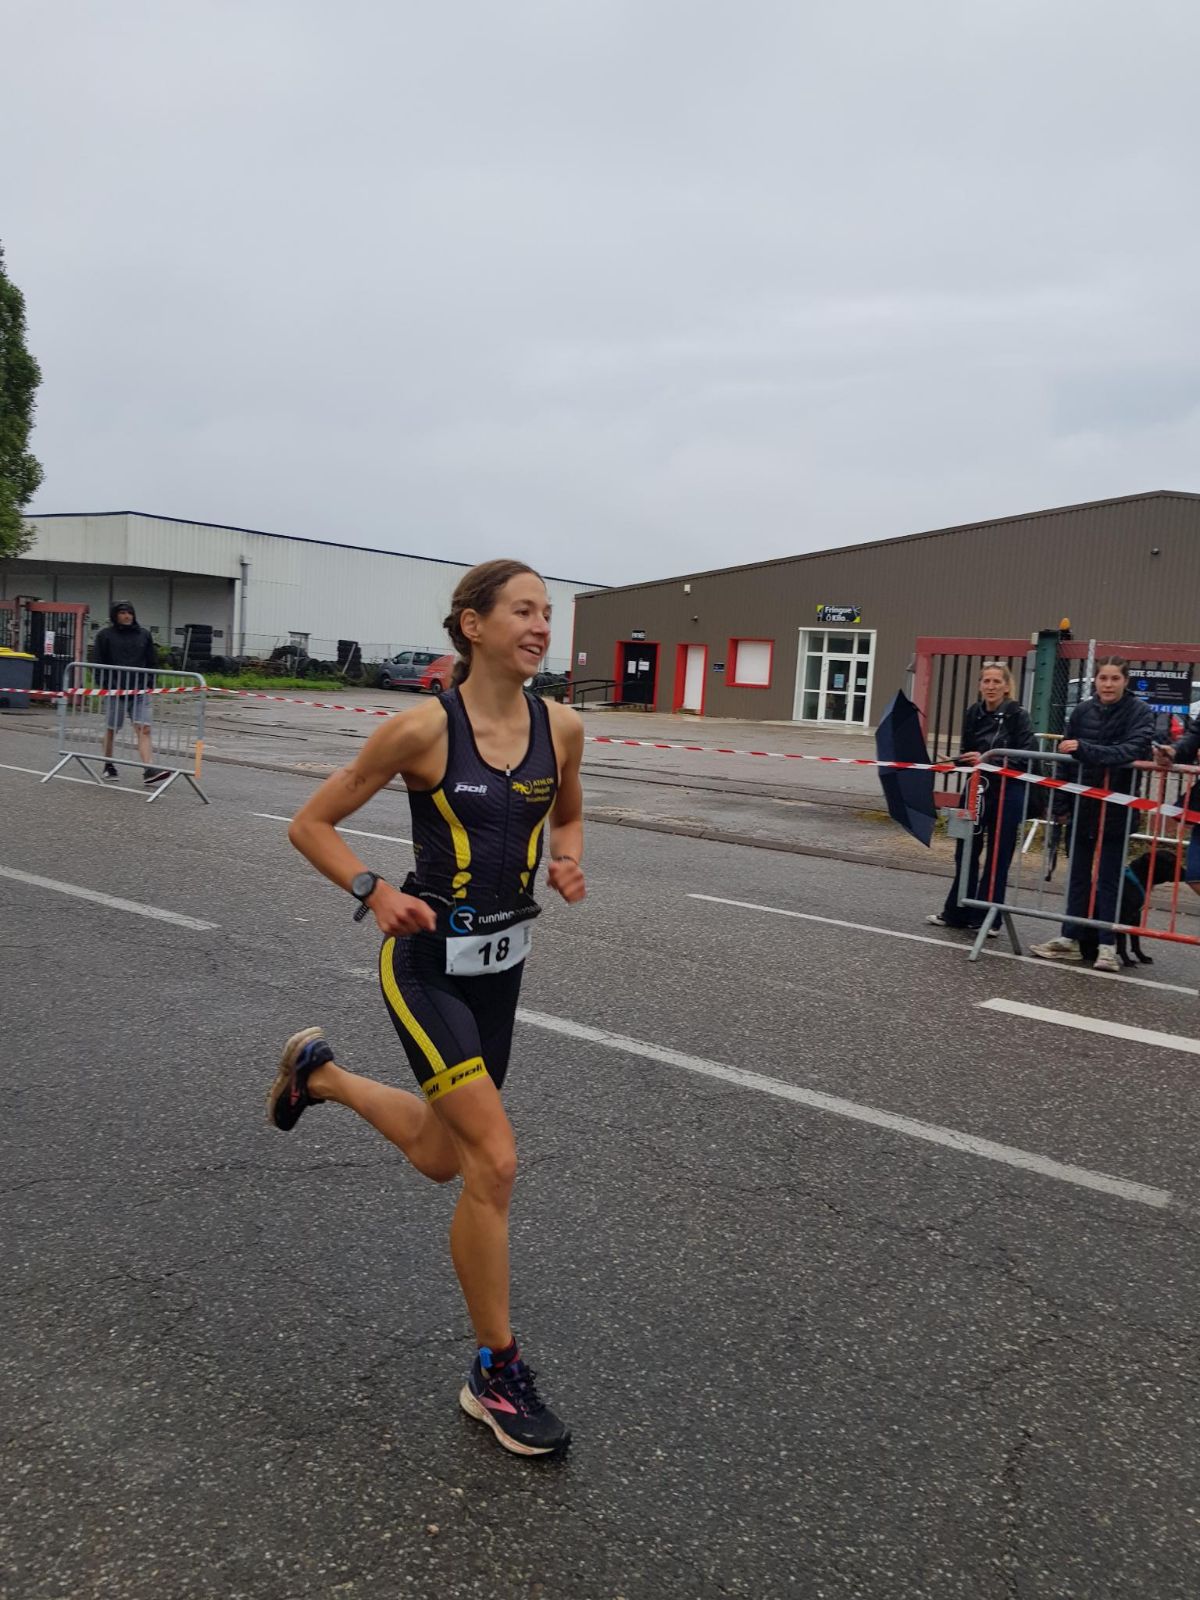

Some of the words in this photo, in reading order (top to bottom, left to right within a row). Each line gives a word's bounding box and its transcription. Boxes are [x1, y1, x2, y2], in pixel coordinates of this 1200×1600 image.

[1146, 671, 1188, 680] SURVEILLÉ
[454, 782, 488, 794] poli
[478, 936, 510, 966] 18
